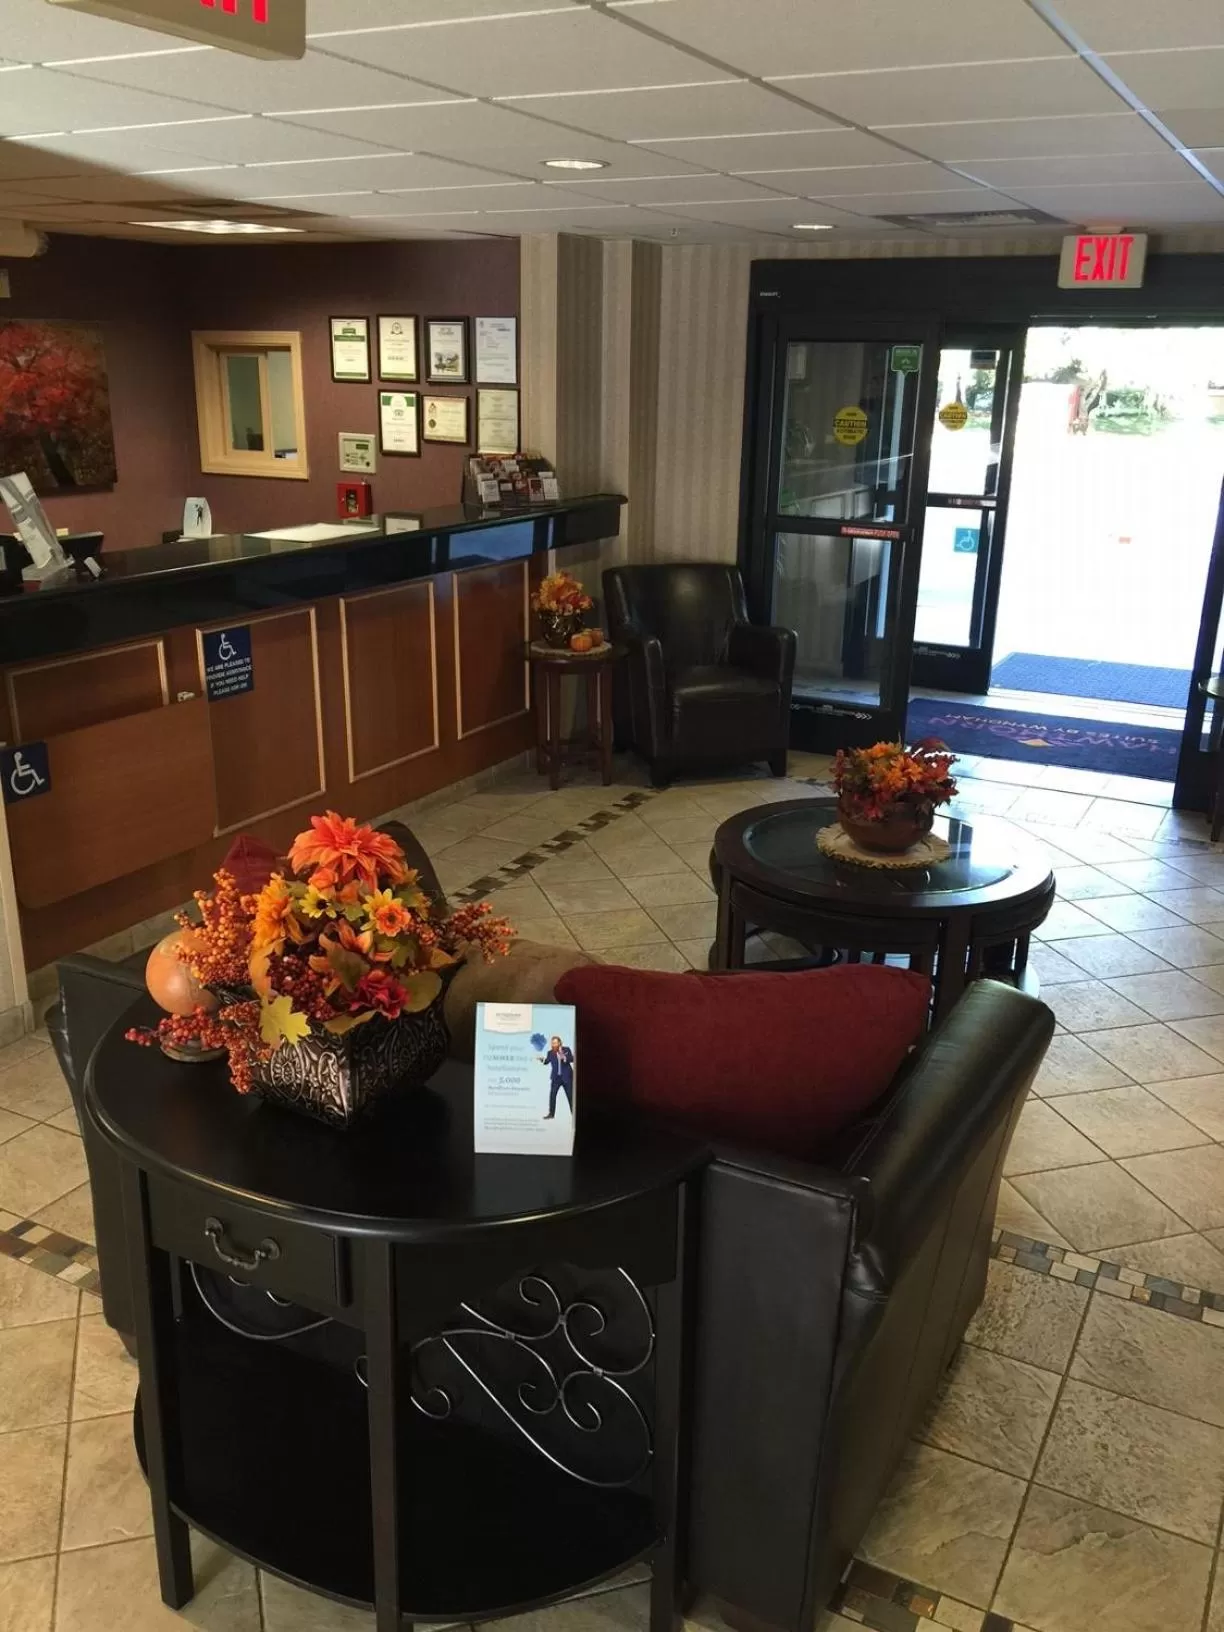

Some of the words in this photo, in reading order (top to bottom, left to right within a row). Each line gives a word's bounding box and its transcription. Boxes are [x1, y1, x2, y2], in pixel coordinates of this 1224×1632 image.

[1074, 236, 1134, 281] EXIT
[834, 420, 867, 429] CAUTION
[944, 713, 1048, 732] WYNDHAM
[1054, 726, 1081, 735] BY
